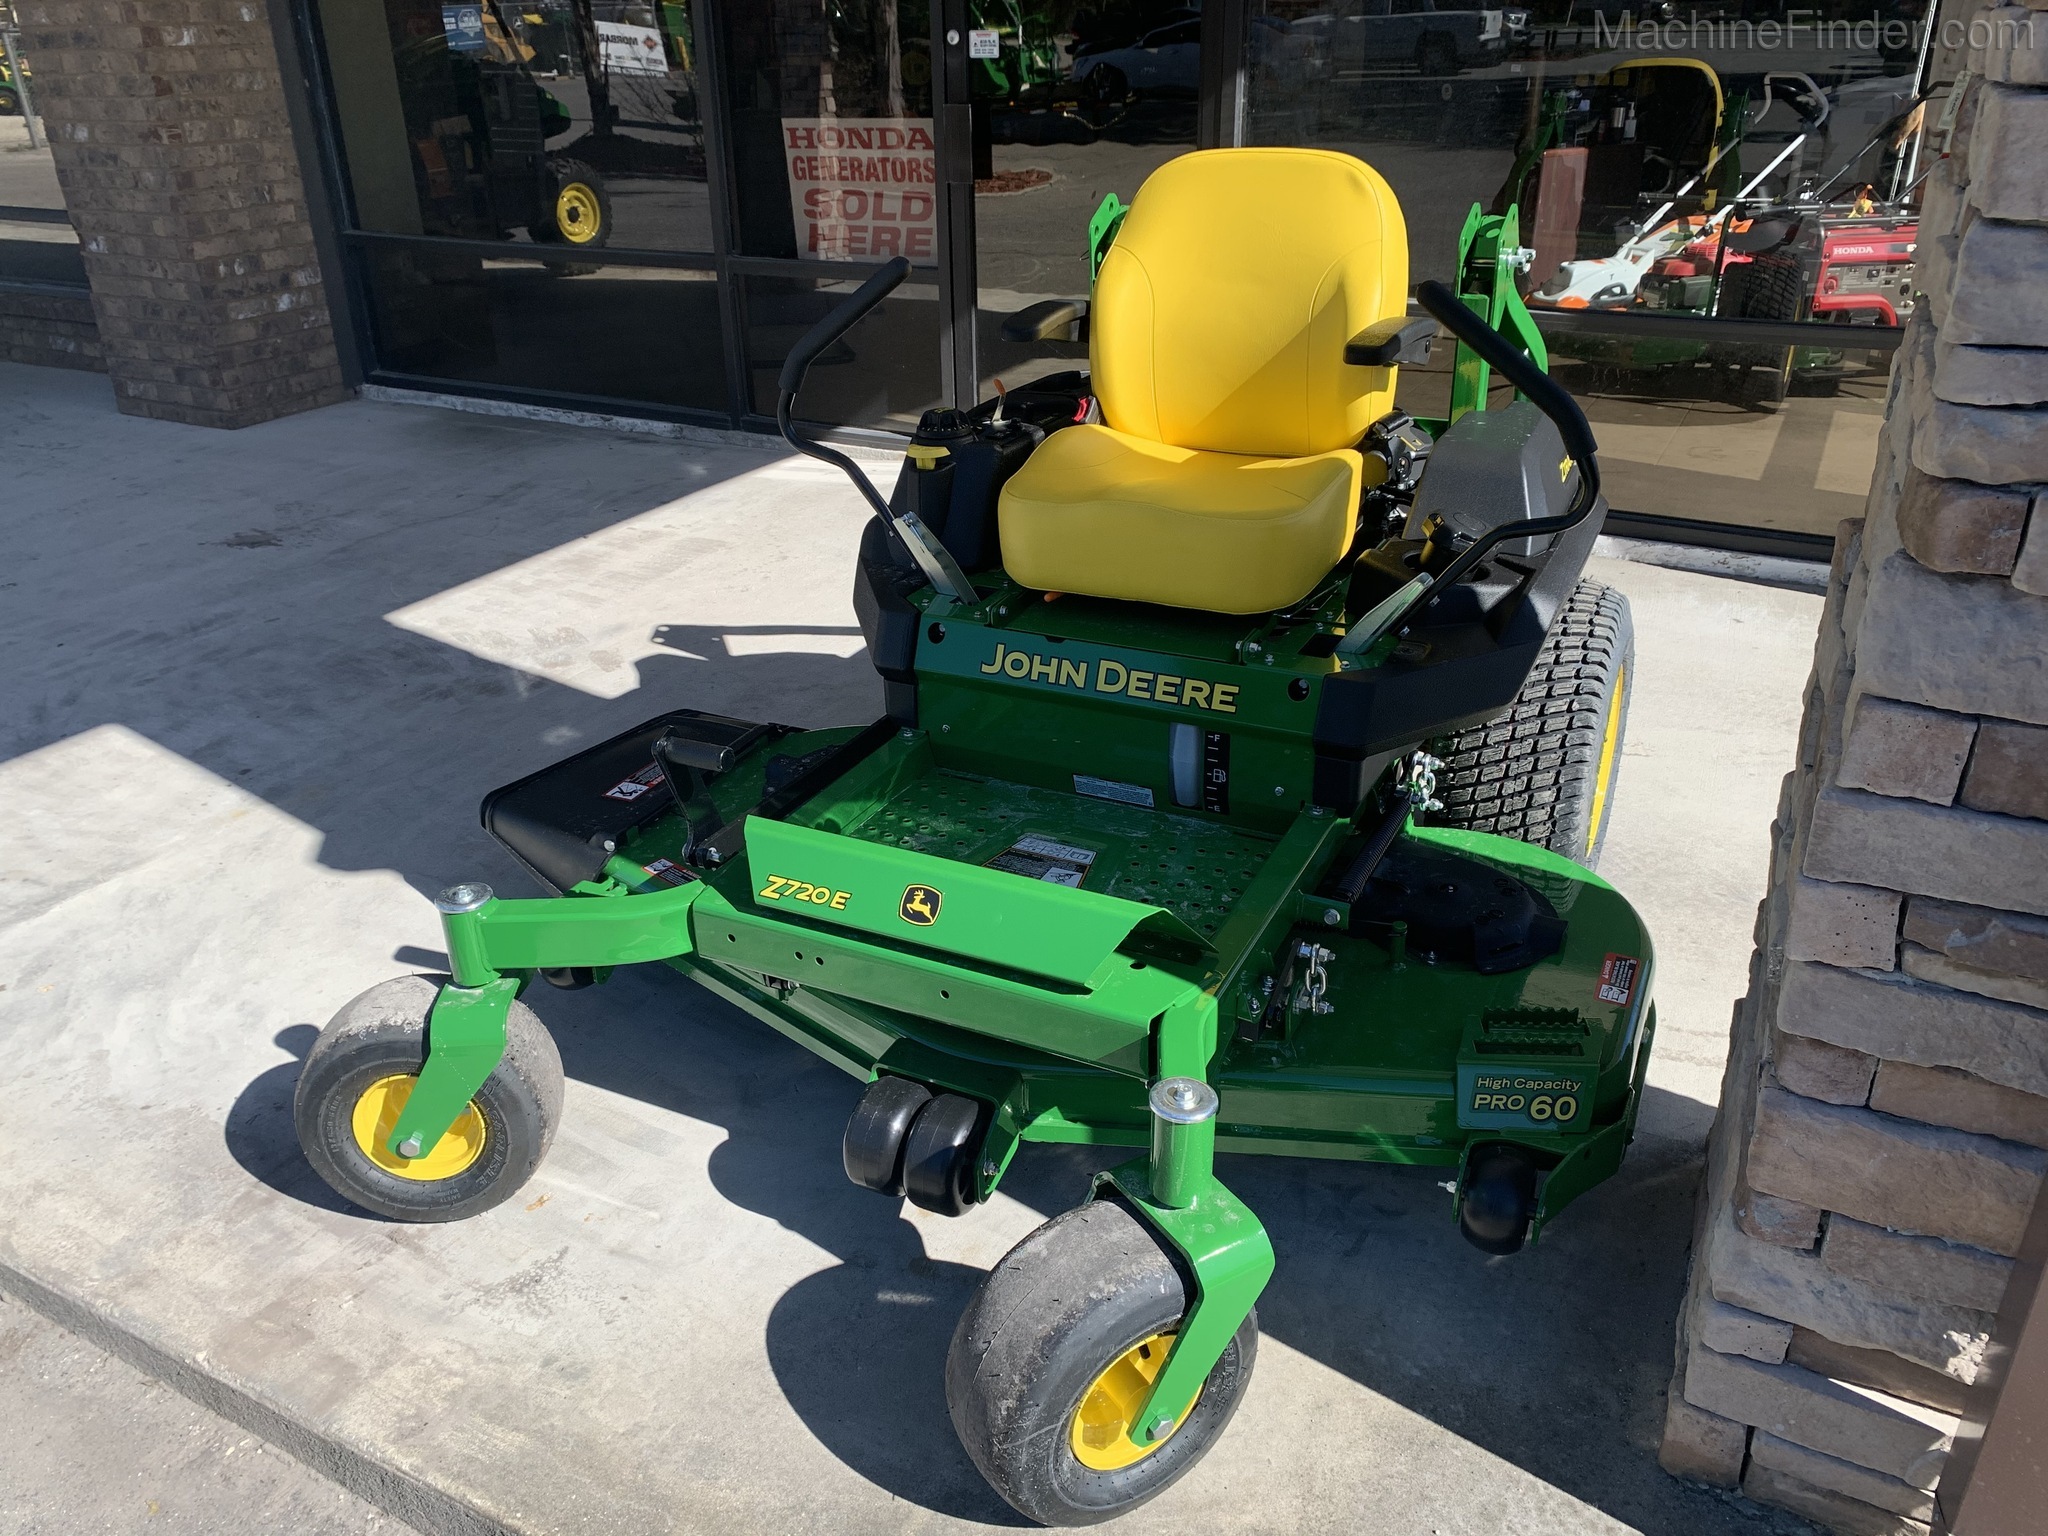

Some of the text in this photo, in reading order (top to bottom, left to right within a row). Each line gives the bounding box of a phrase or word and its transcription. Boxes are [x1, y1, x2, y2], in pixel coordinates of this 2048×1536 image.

[785, 127, 935, 150] HONDA
[792, 155, 936, 184] GENERATORS
[803, 187, 935, 222] SOLD
[808, 223, 934, 257] HERE
[1833, 246, 1875, 256] HONDA
[980, 642, 1241, 714] JOHN DEERE
[1214, 734, 1221, 742] F
[1477, 1077, 1582, 1092] High Capacity
[1473, 1094, 1578, 1122] PRO 60
